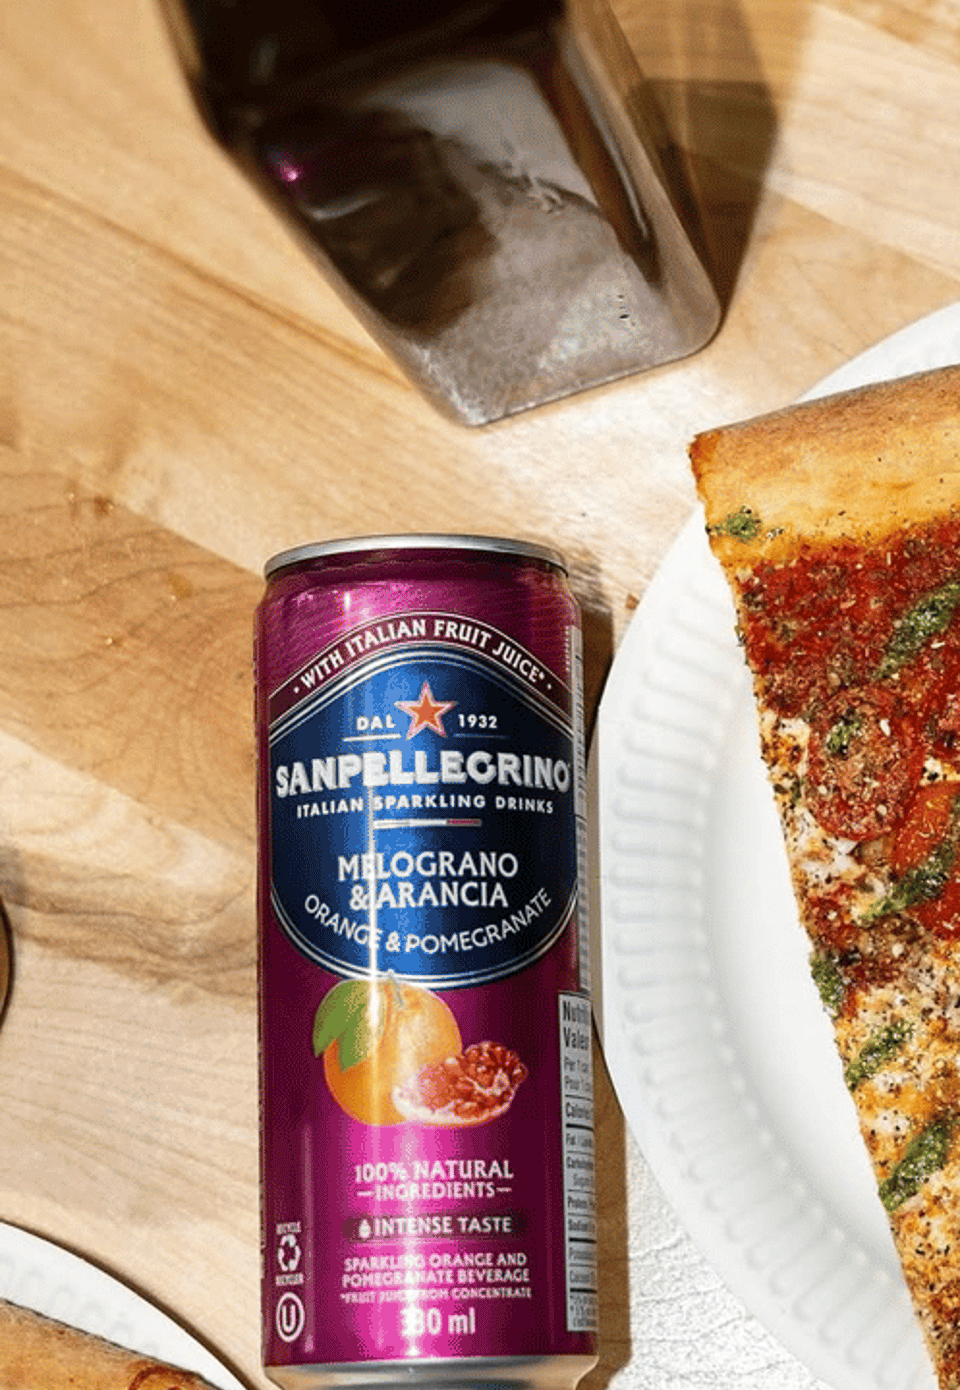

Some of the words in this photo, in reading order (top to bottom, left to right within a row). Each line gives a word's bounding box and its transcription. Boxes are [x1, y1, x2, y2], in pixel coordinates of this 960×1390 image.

[301, 650, 345, 689] WITH
[345, 619, 426, 658] ITALIAN
[433, 621, 492, 650] FRUIT
[356, 714, 396, 731] DAL
[458, 713, 498, 729] 1932
[275, 748, 572, 799] SANPELLEGRINO
[296, 796, 364, 819] ITALIAN
[372, 794, 487, 811] SPARKLING
[495, 795, 555, 815] DRINKS
[337, 851, 519, 882] MELOGRANO
[304, 894, 384, 950] ORANGE
[385, 930, 401, 953] &
[404, 887, 552, 954] POMEGRANATE
[355, 1161, 409, 1183] 100%
[412, 1159, 514, 1181] NATURAL
[373, 1217, 454, 1237] INTENSE
[457, 1215, 513, 1234] TASTE
[428, 1253, 493, 1268] ORANGE
[496, 1252, 528, 1267] AND
[457, 1268, 530, 1285] BEVERAGE
[447, 1306, 476, 1335] ml
